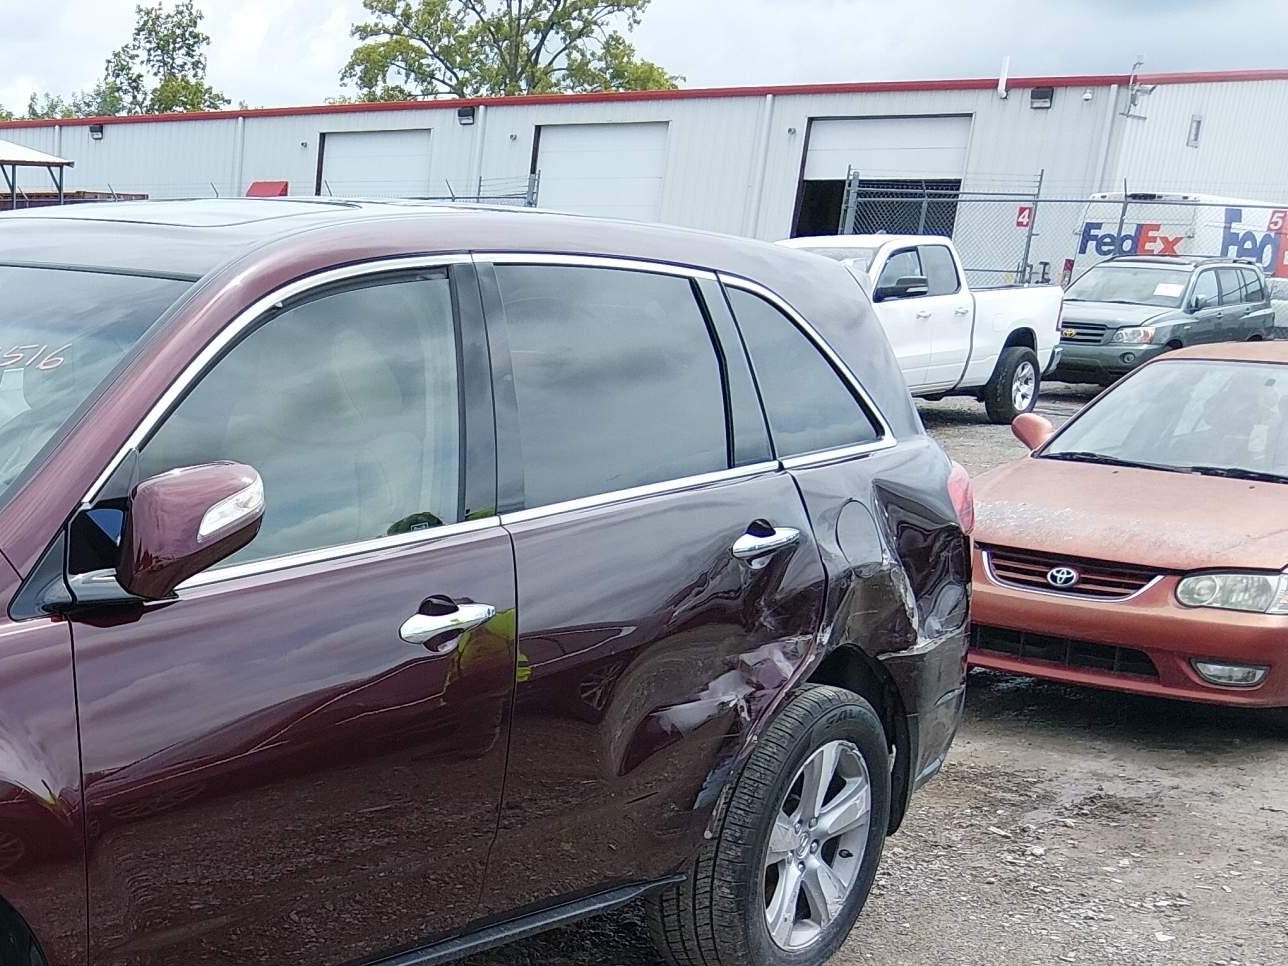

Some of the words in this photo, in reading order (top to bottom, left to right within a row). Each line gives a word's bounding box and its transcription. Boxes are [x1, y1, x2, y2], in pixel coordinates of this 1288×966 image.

[1017, 209, 1030, 227] 4
[1269, 212, 1285, 230] 5
[1079, 222, 1184, 257] FedEx
